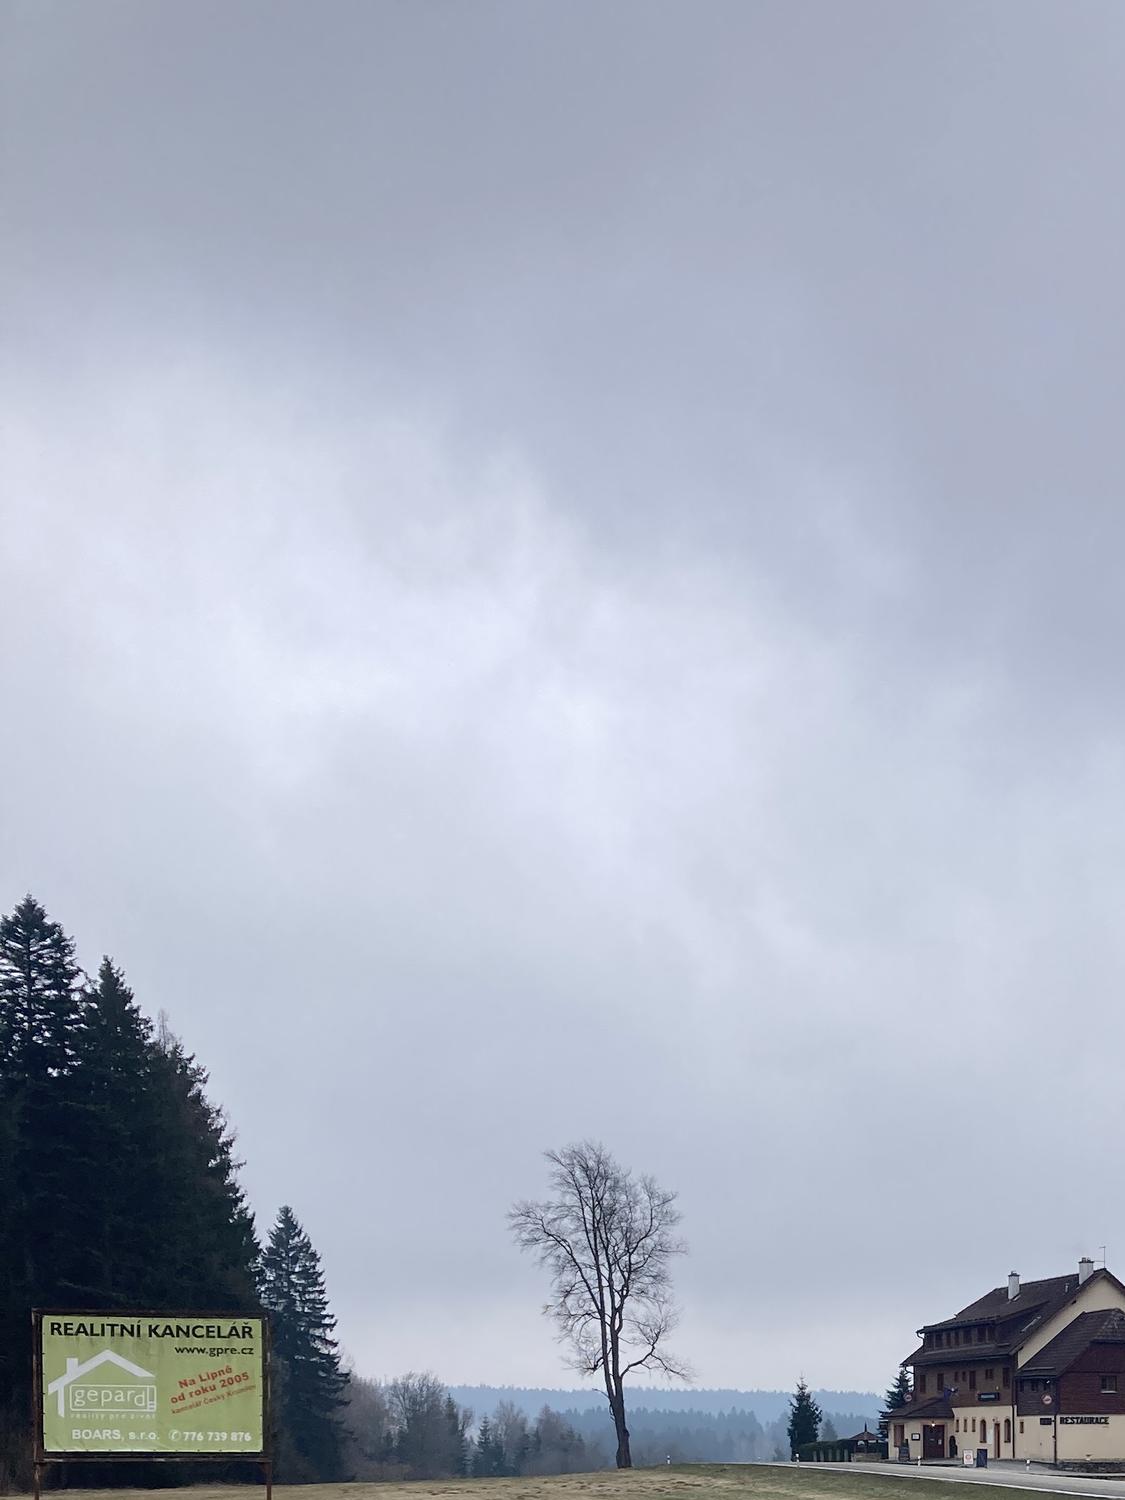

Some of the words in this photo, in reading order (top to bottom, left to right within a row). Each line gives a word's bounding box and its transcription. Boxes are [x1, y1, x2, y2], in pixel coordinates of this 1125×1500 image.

[50, 1320, 142, 1338] REALITNÍ
[148, 1321, 253, 1339] KANCELÁŘ
[174, 1345, 254, 1357] www.gpre.cz
[170, 1392, 186, 1404] od
[189, 1384, 217, 1398] roku
[219, 1371, 249, 1389] 2005
[178, 1377, 196, 1389] Na
[73, 1386, 148, 1408] gepard
[1059, 1416, 1110, 1425] RESTAURACE
[72, 1429, 125, 1441] BOARS,
[128, 1431, 160, 1440] s.r.o.
[183, 1432, 204, 1442] 776
[207, 1432, 228, 1442] 739
[230, 1432, 252, 1442] 876
